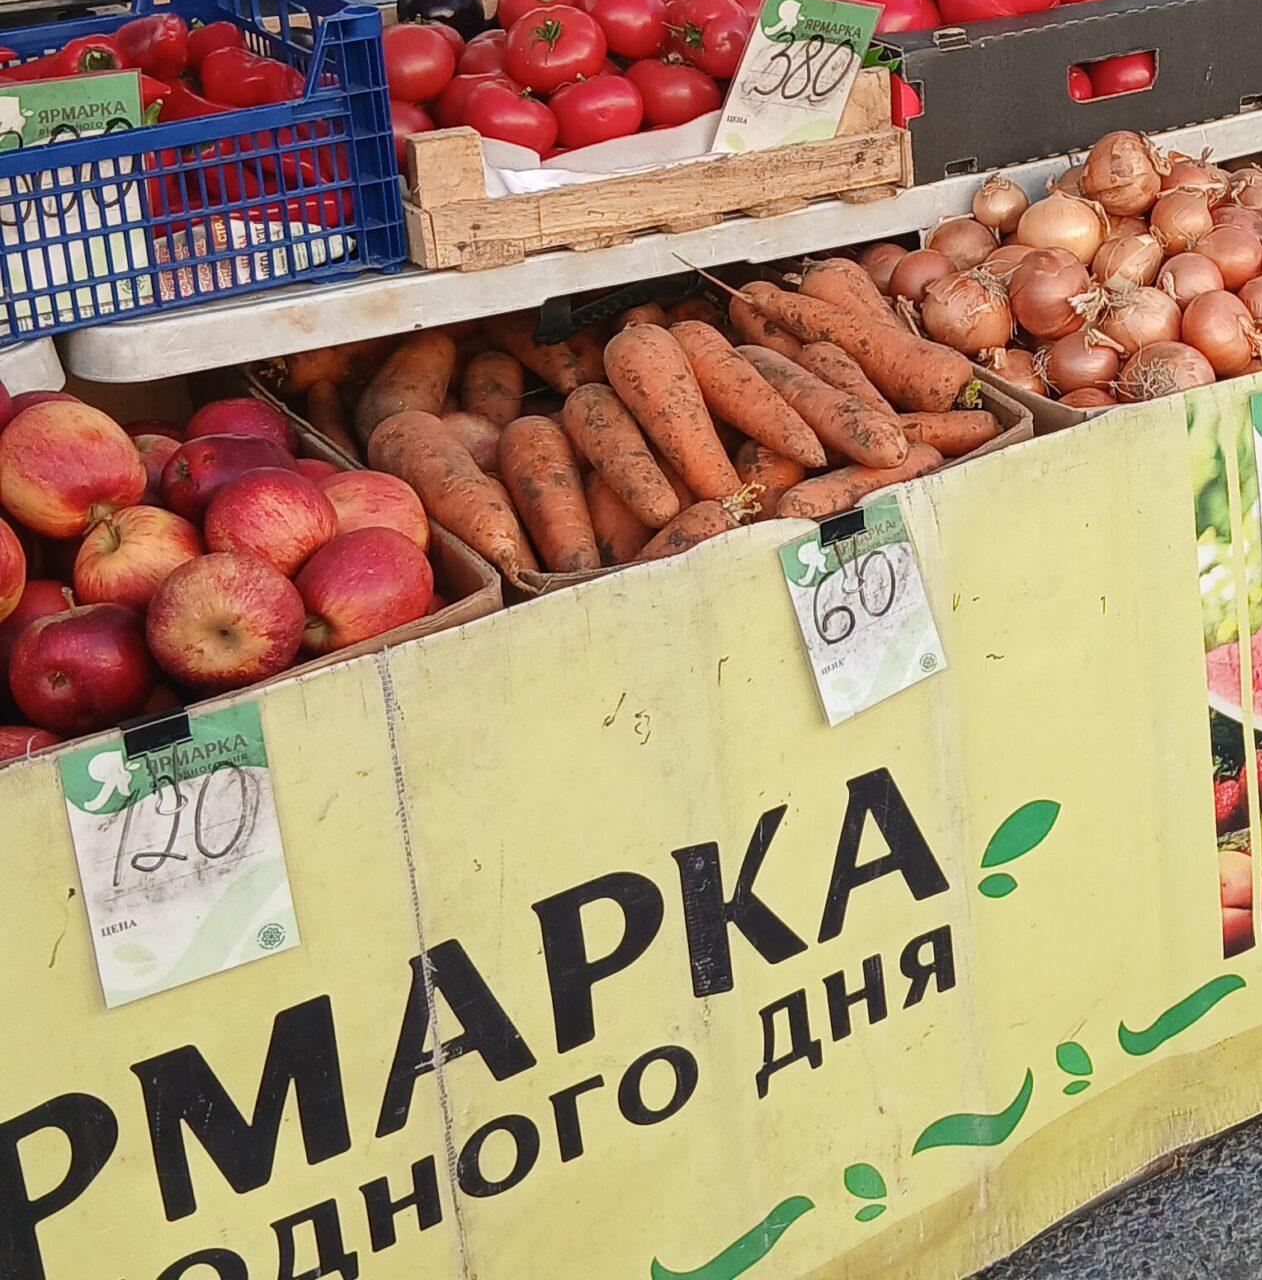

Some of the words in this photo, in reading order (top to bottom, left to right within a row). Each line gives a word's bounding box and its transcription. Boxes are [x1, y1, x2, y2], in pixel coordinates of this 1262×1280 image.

[804, 18, 862, 39] ЯРМАРКА
[752, 31, 855, 100] 380
[37, 100, 127, 125] ЯРМАРКА
[813, 550, 896, 645] 60
[145, 733, 249, 777] ЯРМАРКА
[108, 760, 249, 887] 120
[101, 918, 137, 937] ЦЕНА
[756, 924, 957, 1098] дня
